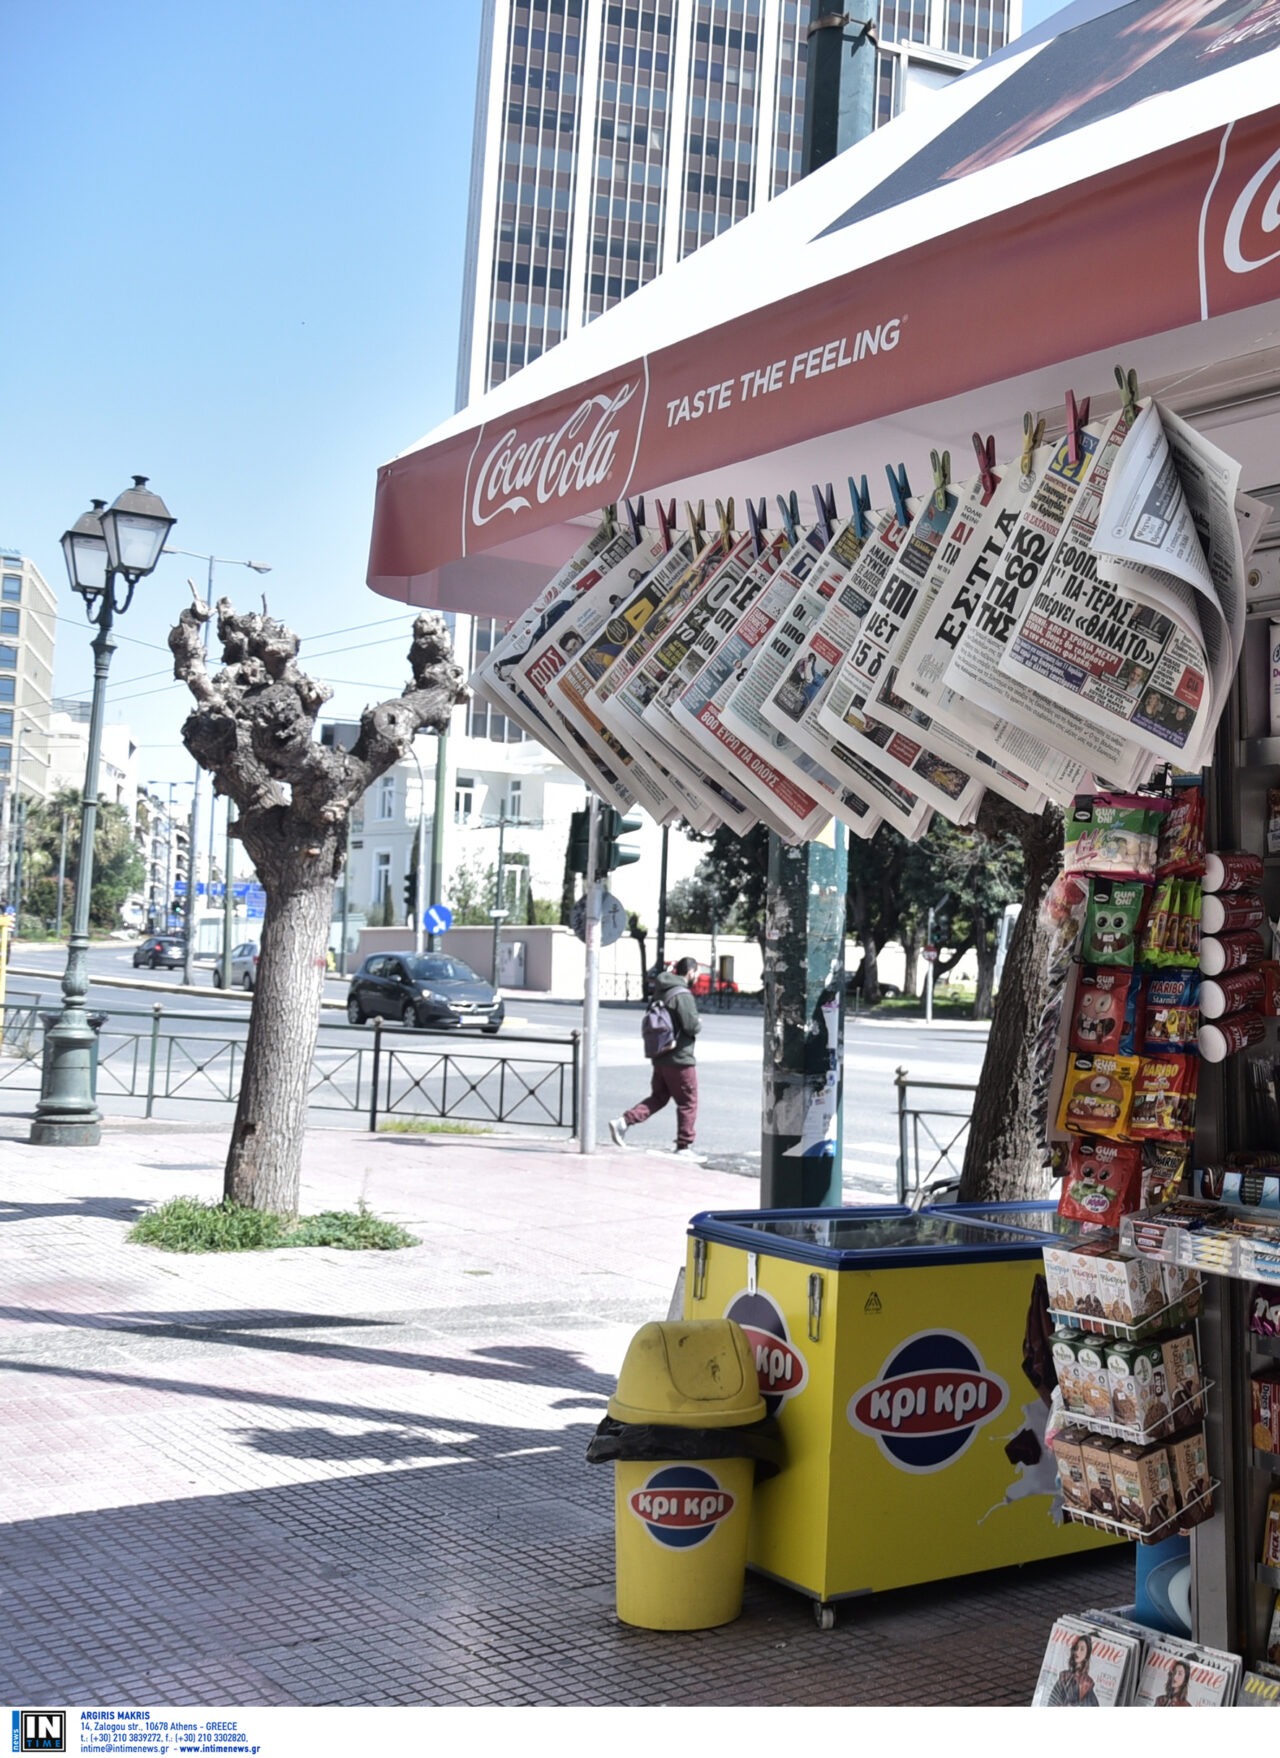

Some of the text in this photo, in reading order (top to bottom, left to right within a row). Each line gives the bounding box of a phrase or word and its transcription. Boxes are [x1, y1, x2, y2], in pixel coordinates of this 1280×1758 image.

[667, 318, 901, 427] TASTE THE FEELING
[472, 378, 641, 526] Coca-Cola
[935, 508, 1021, 649] ΕΣΤΙΑ
[986, 576, 1020, 614] ΓΙΑ
[976, 602, 1017, 643] ΤΗΣ
[1063, 577, 1134, 628] ΠΑ-ΤΕΡΑΣ
[1076, 612, 1155, 664] «ΘΑΝΑΤΟ»
[700, 711, 780, 788] 800 ΕΥΡΩ ΓΙΑ ΟΛΟΥΣ
[1095, 808, 1116, 817] GUM
[1114, 891, 1136, 900] GUM
[1151, 980, 1185, 994] HARIBO
[1143, 1063, 1179, 1077] HARIBO
[1271, 1533, 1280, 1560] PICK
